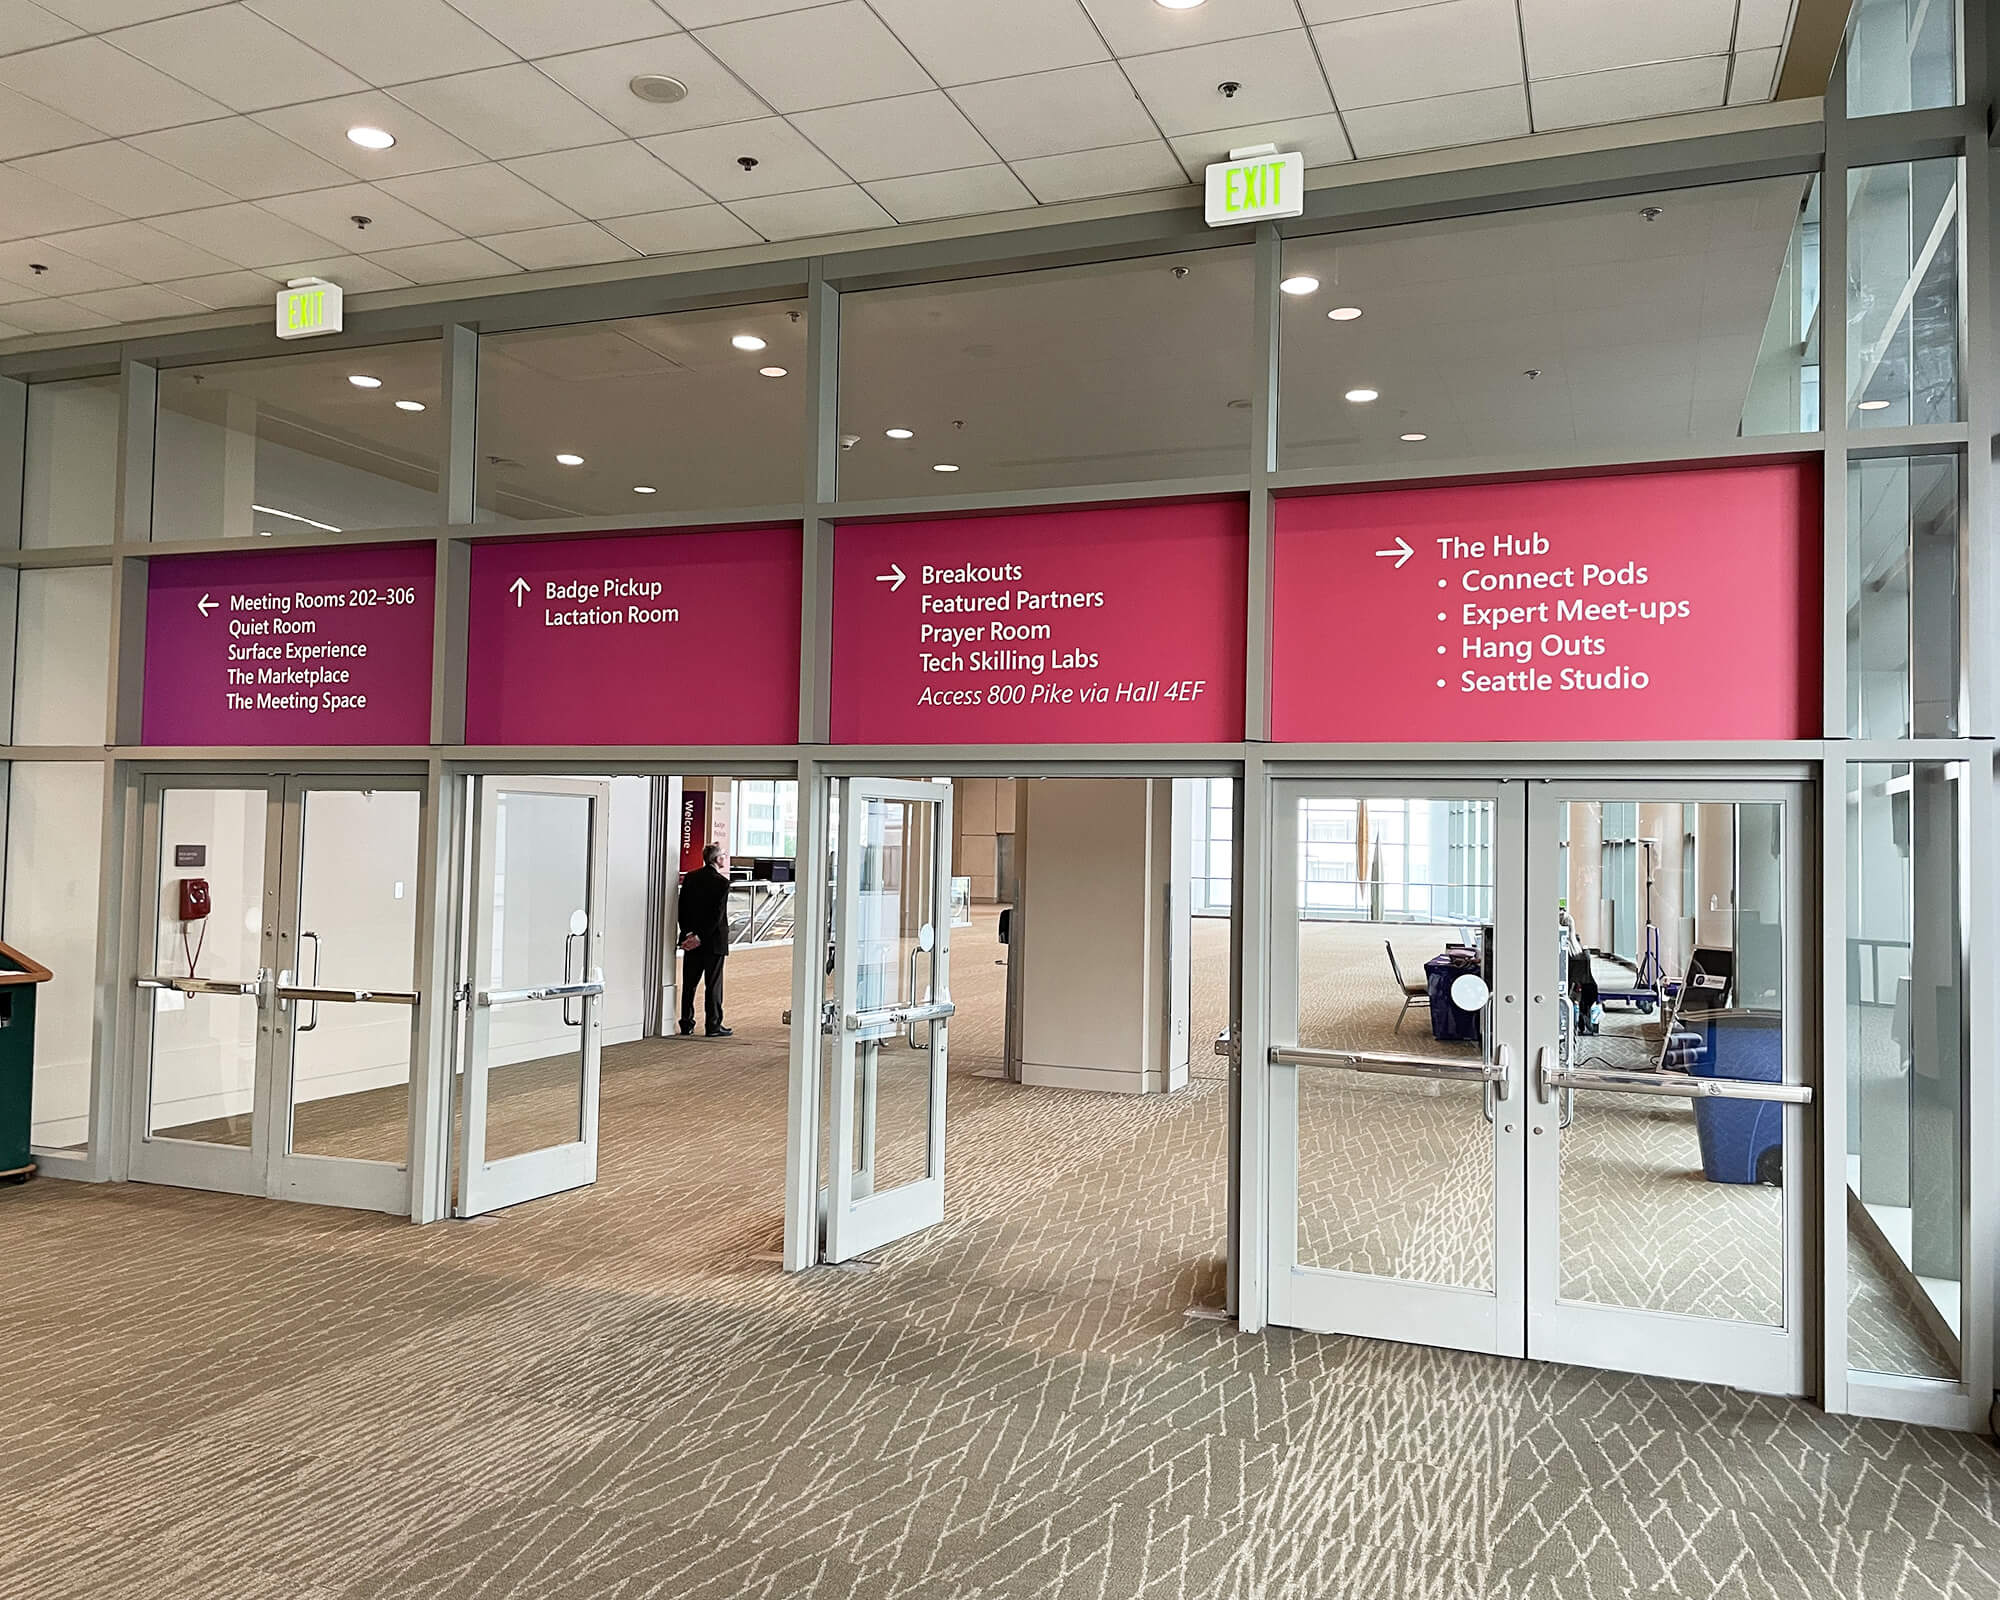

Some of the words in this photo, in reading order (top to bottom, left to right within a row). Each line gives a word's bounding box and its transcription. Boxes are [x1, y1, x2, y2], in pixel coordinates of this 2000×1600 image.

[1225, 161, 1286, 212] EXIT
[288, 291, 325, 329] EXIT
[1436, 536, 1486, 560] The
[1493, 531, 1550, 557] Hub
[922, 562, 1023, 585] Breakouts
[1462, 566, 1575, 592] Connect
[1582, 560, 1649, 587] Pods
[230, 592, 291, 614] Meeting
[295, 592, 346, 609] Rooms
[348, 587, 415, 607] 202–306
[546, 580, 600, 604] Badge
[603, 577, 662, 601] Pickup
[921, 590, 1010, 614] Featured
[1016, 590, 1104, 610] Partners
[545, 606, 623, 626] Lactation
[628, 605, 679, 624] Room
[1462, 601, 1549, 631] Expert
[1556, 598, 1691, 625] Meet-ups
[229, 618, 270, 640] Quiet
[273, 617, 316, 634] Room
[921, 623, 986, 648] Prayer
[990, 621, 1051, 641] Room
[227, 642, 282, 661] Surface
[285, 640, 367, 664] Experience
[919, 651, 964, 673] Tech
[969, 649, 1045, 675] Skilling
[1051, 647, 1099, 669] Labs
[1462, 636, 1533, 664] Hang
[1540, 633, 1606, 657] Outs
[227, 667, 255, 685] The
[257, 665, 350, 689] Marketplace
[1461, 667, 1553, 693] Seattle
[1559, 664, 1650, 691] Studio
[225, 692, 254, 710] The
[256, 691, 319, 714] Meeting
[322, 691, 367, 713] Space
[917, 686, 983, 706] Access
[986, 684, 1026, 705] 800
[1030, 682, 1074, 704] Pike
[1079, 682, 1110, 703] via
[1115, 680, 1160, 703] Hall
[1163, 680, 1207, 702] 4EF
